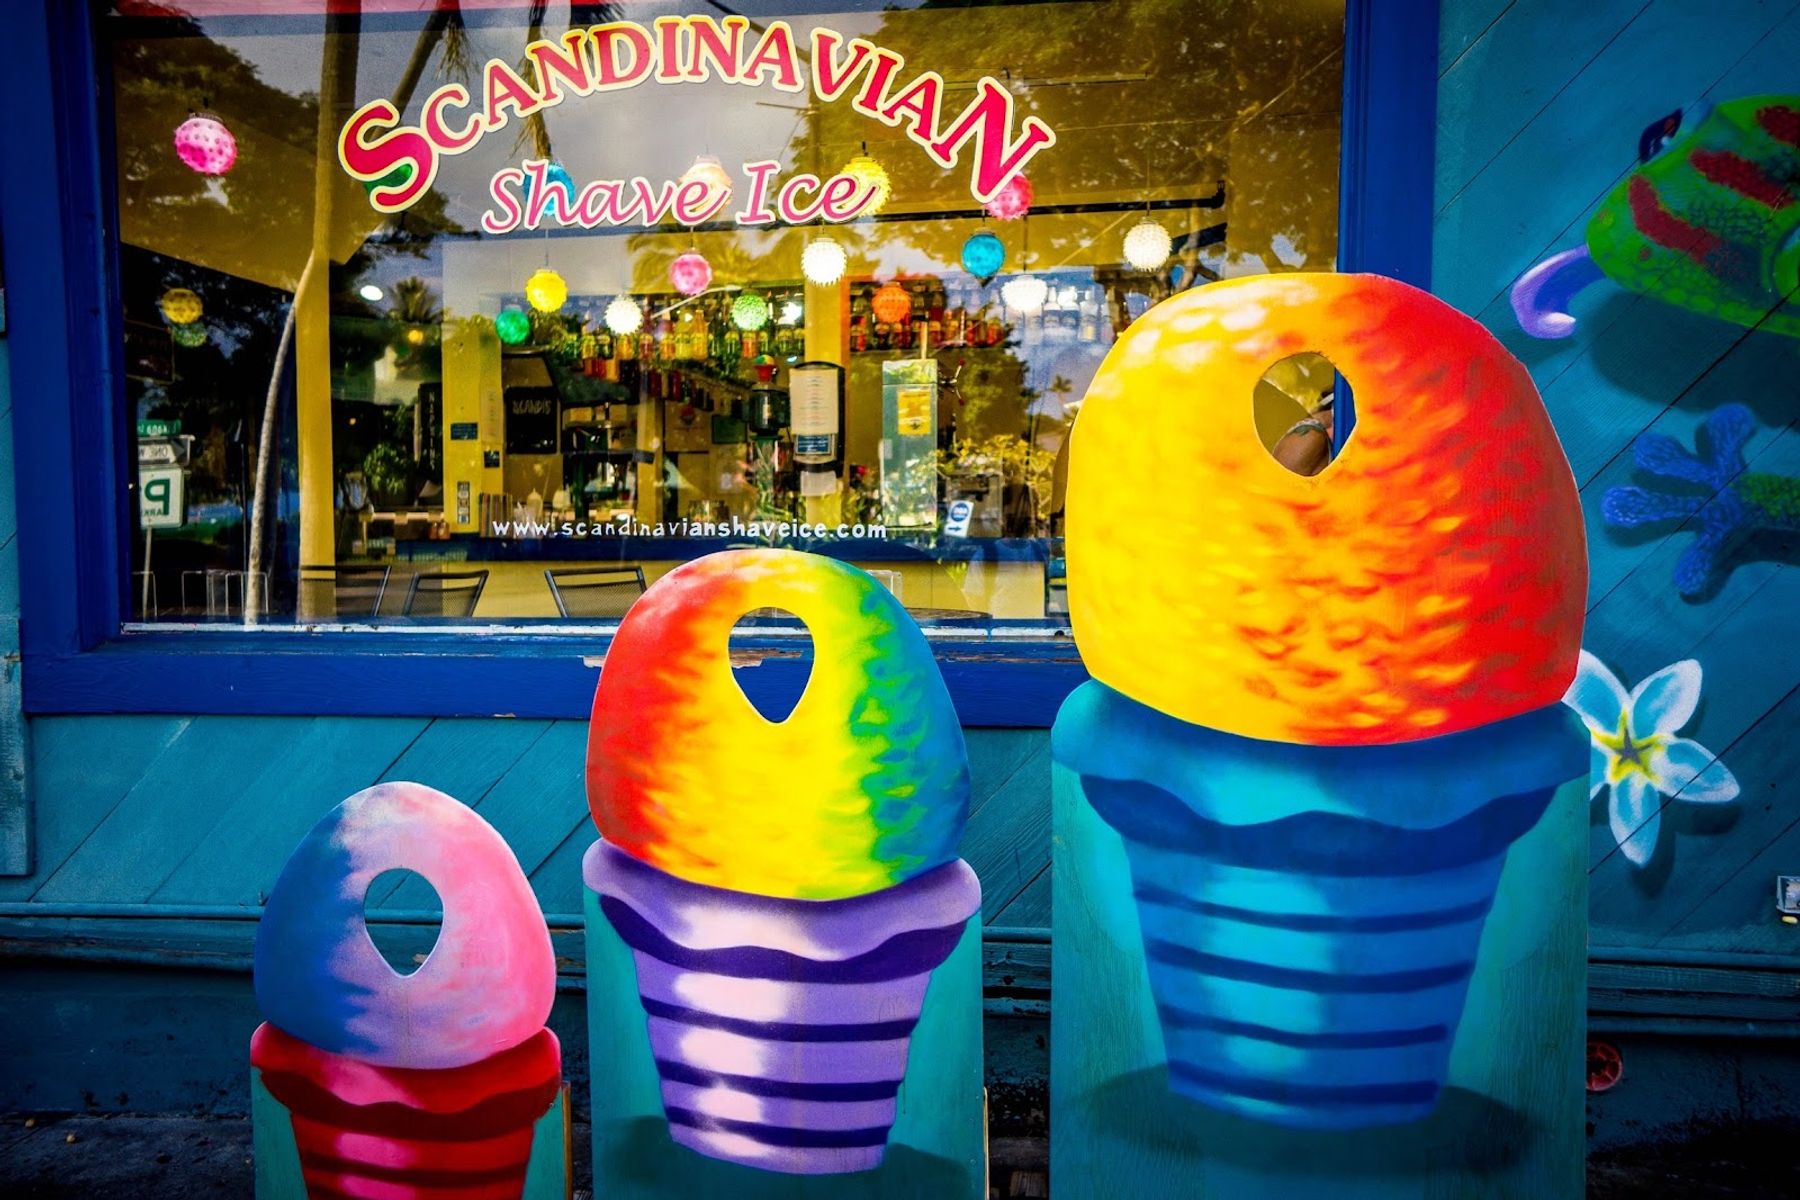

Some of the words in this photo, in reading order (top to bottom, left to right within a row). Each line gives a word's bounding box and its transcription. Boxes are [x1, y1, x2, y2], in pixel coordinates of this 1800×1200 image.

[338, 15, 1057, 214] SCANDINAVIAN
[481, 157, 734, 234] Shave
[736, 159, 877, 226] Ice
[492, 515, 888, 539] www.scandinavianshaveice.com
